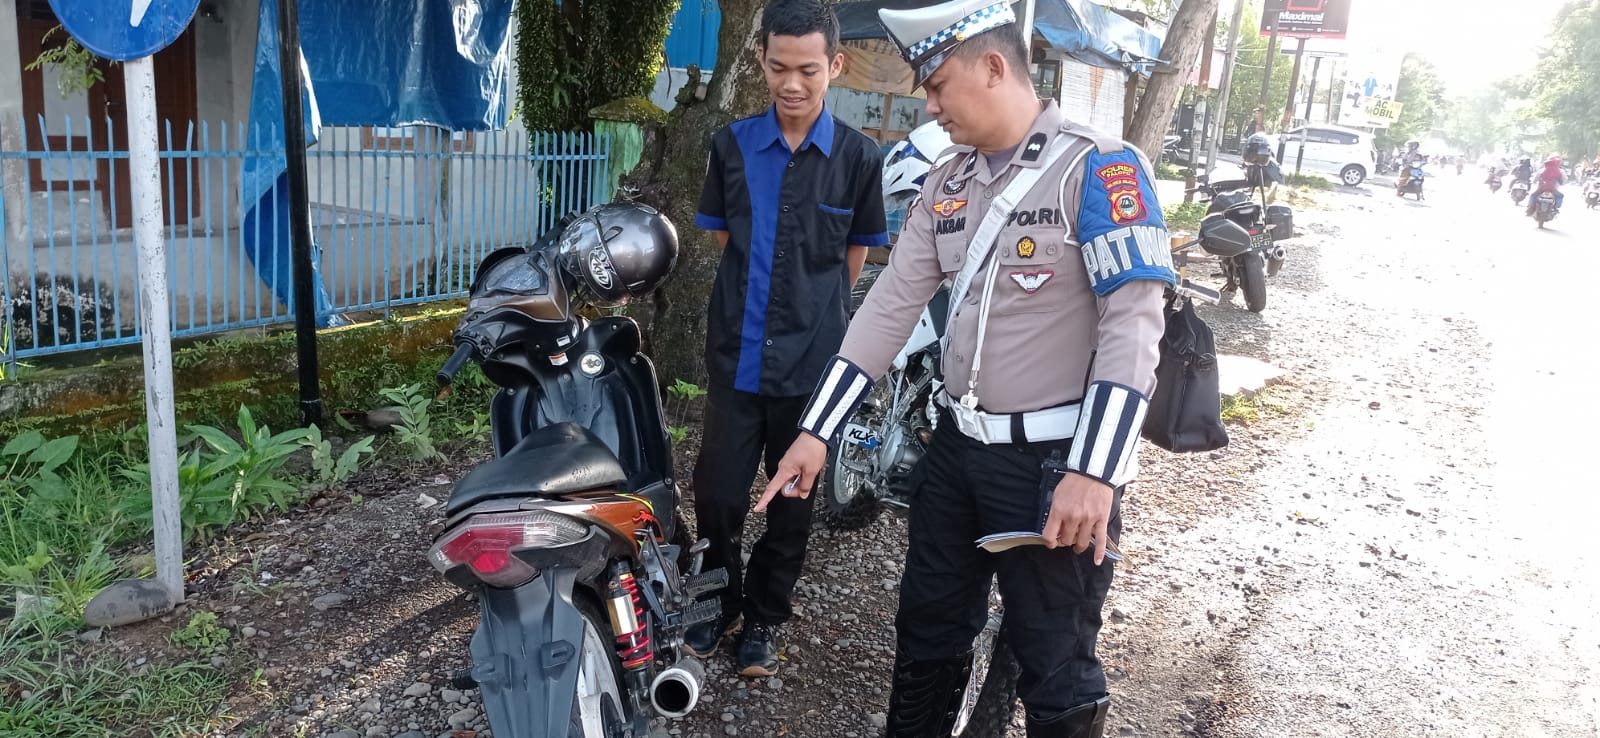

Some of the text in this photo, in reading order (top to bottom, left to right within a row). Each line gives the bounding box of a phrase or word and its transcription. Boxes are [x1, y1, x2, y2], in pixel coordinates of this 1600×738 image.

[1278, 12, 1324, 21] Maximal
[1375, 99, 1388, 109] AC
[1101, 165, 1134, 177] POLRES
[1007, 207, 1060, 227] POLRI
[848, 428, 873, 443] KLX
